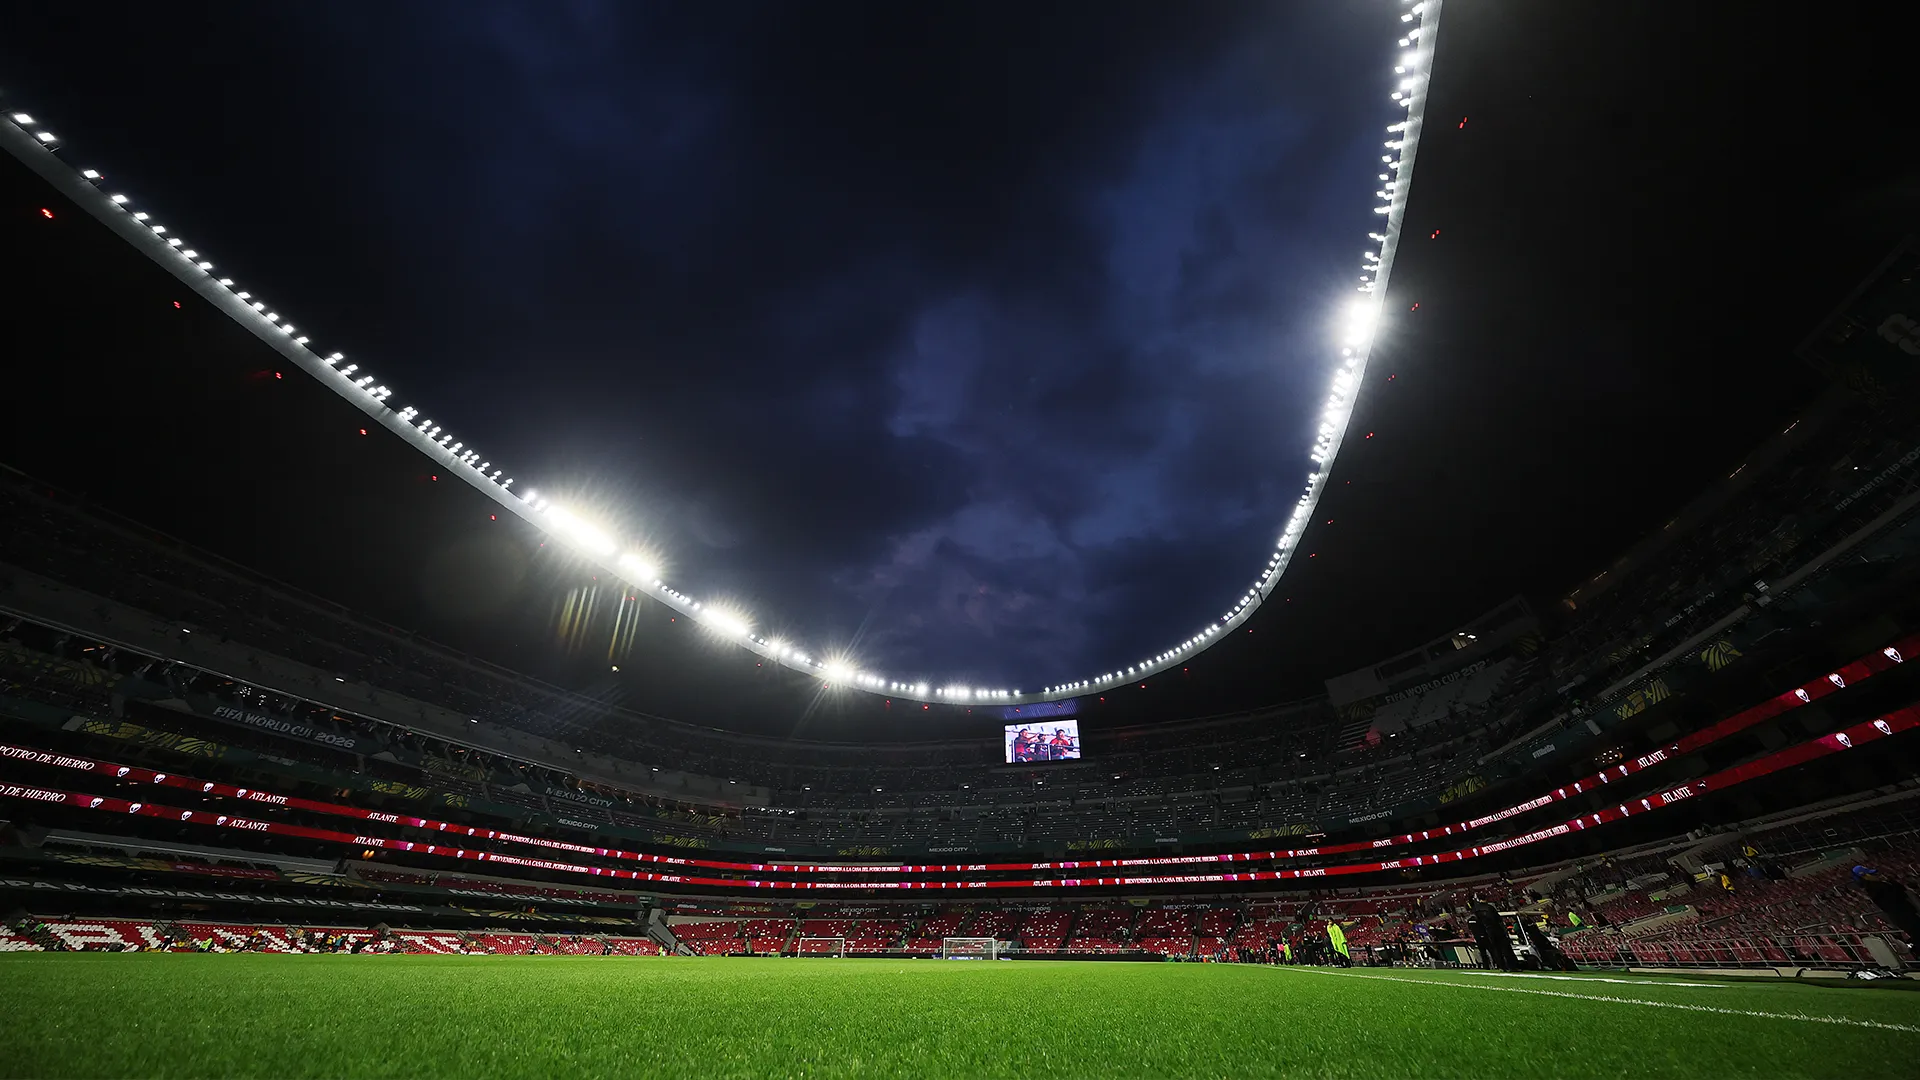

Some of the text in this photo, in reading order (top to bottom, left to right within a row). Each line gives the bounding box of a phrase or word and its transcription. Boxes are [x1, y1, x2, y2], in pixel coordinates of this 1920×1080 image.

[1899, 446, 1920, 466] 20
[1385, 659, 1488, 704] FIFA WORLD CUP 202
[213, 706, 242, 722] FIFA
[244, 712, 291, 733] WORLD
[314, 732, 356, 749] 2026
[0, 746, 95, 770] POTRO DE HIERRO
[1637, 750, 1668, 769] ATLANTE
[4, 786, 24, 797] DE
[22, 789, 66, 802] HIERRO
[249, 792, 288, 805] ATLANTE
[1660, 786, 1693, 804] ATLANTE
[589, 797, 613, 808] CITY
[229, 819, 270, 832] ATLANTE
[367, 812, 398, 823] ATLANTE
[1349, 810, 1393, 825] MEXICO CITY
[582, 822, 599, 830] CITY
[352, 836, 385, 847] ATLANTE
[0, 880, 60, 890] PA
[215, 892, 254, 901] DE
[257, 895, 292, 905] LA
[292, 898, 347, 907] FIFA
